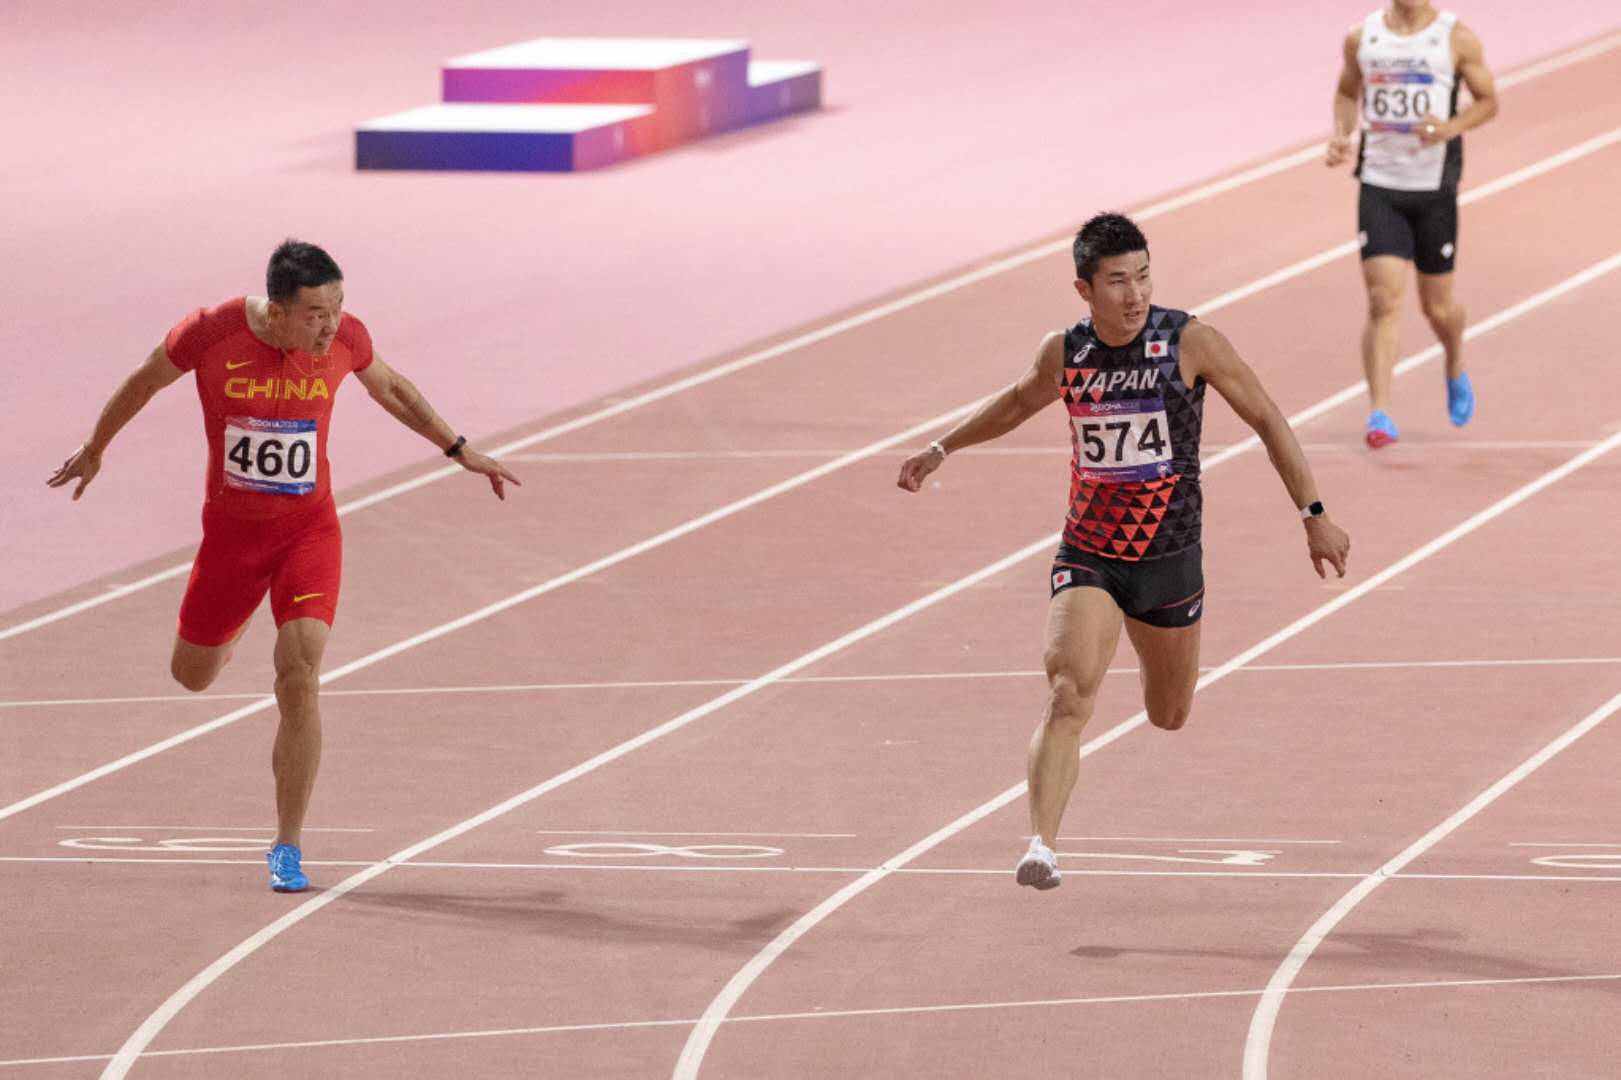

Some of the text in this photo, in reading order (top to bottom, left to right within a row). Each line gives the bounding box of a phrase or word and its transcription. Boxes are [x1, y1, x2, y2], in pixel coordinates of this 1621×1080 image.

[1373, 88, 1430, 117] 630
[225, 377, 329, 400] CHINA
[1073, 368, 1160, 394] JAPAN
[1082, 418, 1166, 462] 574
[229, 436, 311, 478] 460
[544, 842, 784, 858] 8
